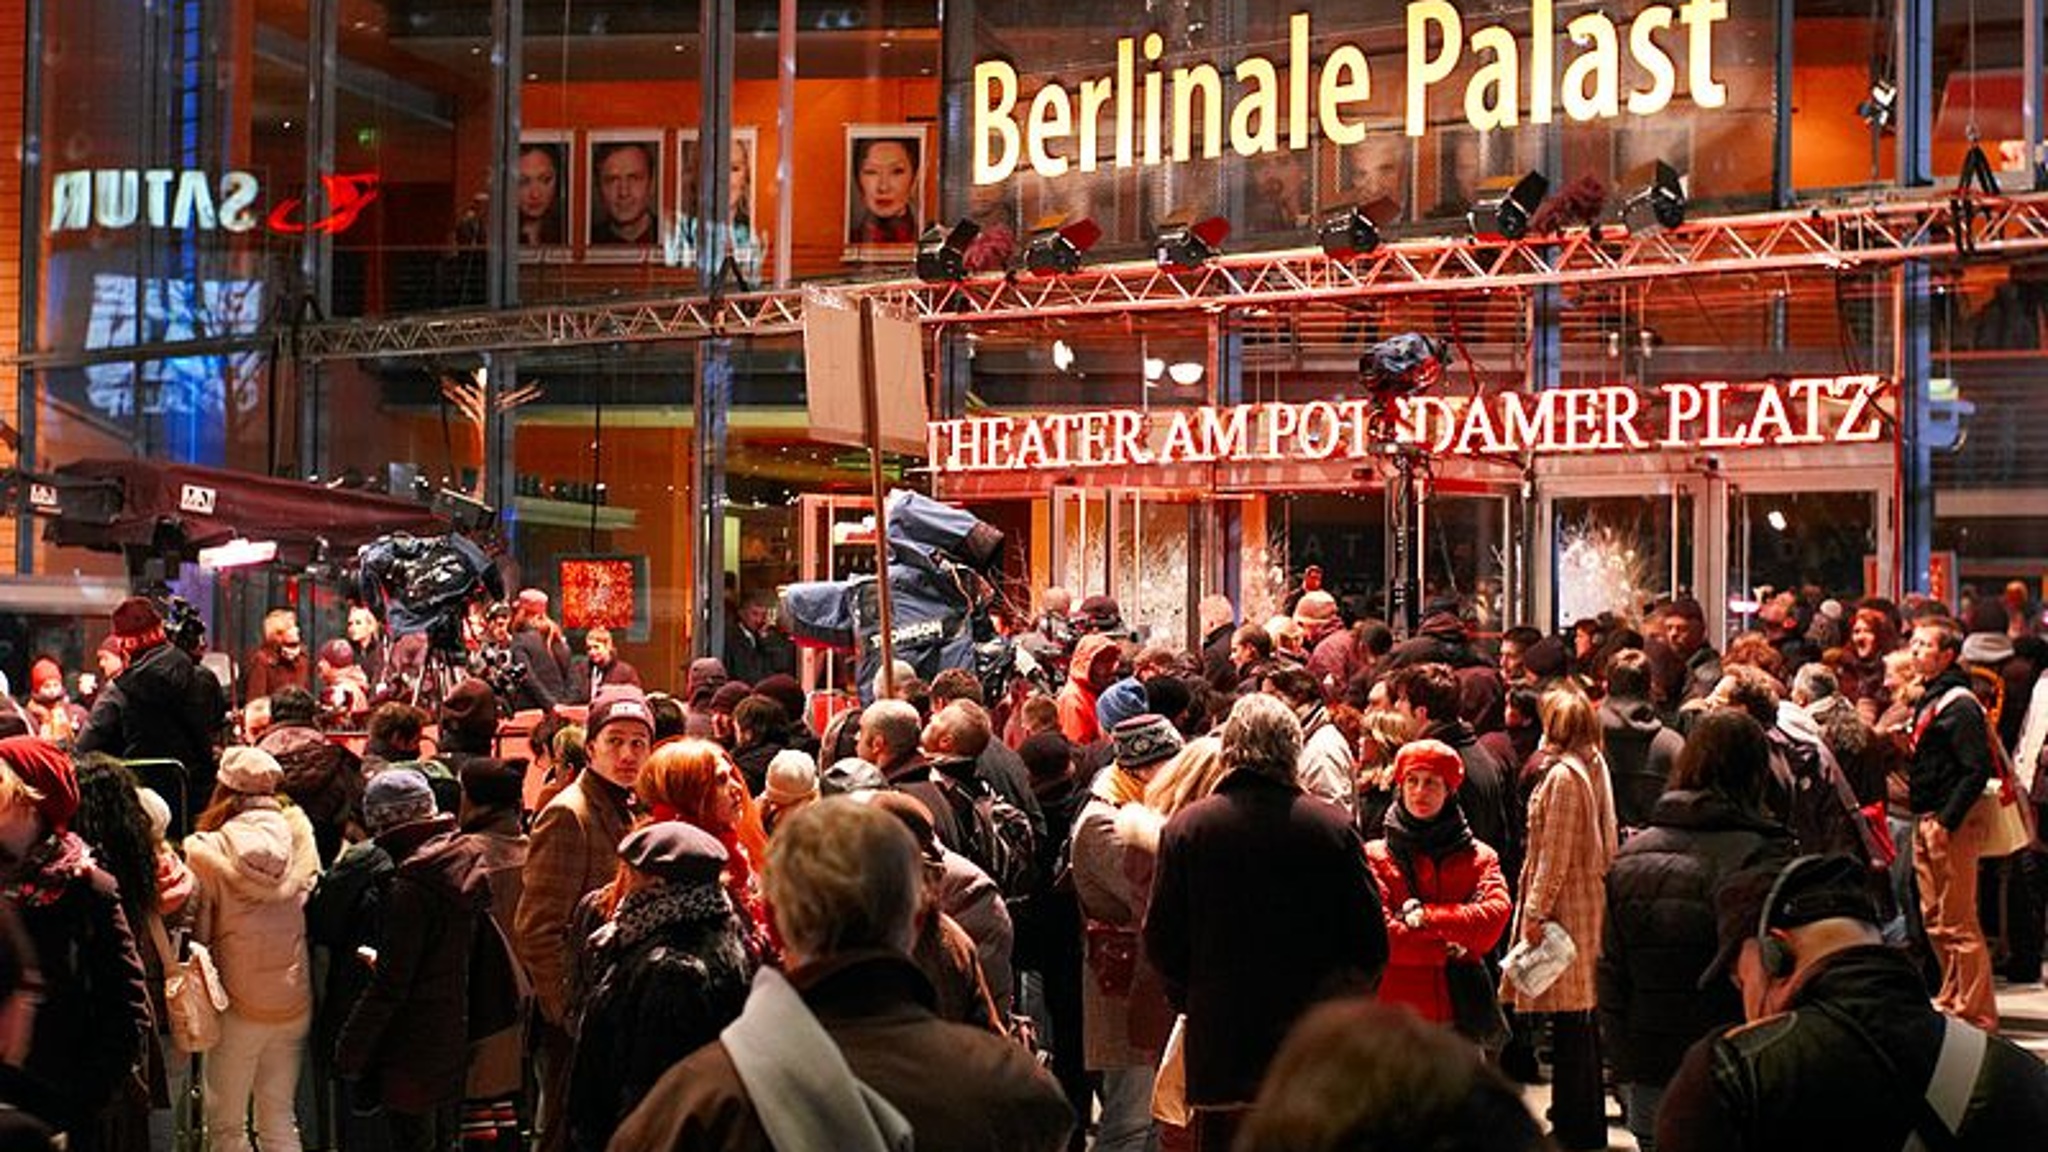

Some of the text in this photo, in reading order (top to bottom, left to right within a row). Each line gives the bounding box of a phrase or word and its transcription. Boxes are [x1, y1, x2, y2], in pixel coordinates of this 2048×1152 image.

[973, 0, 1728, 186] Berlinale Palast
[925, 409, 1151, 472] THEATER
[1157, 402, 1256, 464] AM
[1658, 375, 1881, 448] PLATZ
[869, 618, 944, 649] TOMSON
